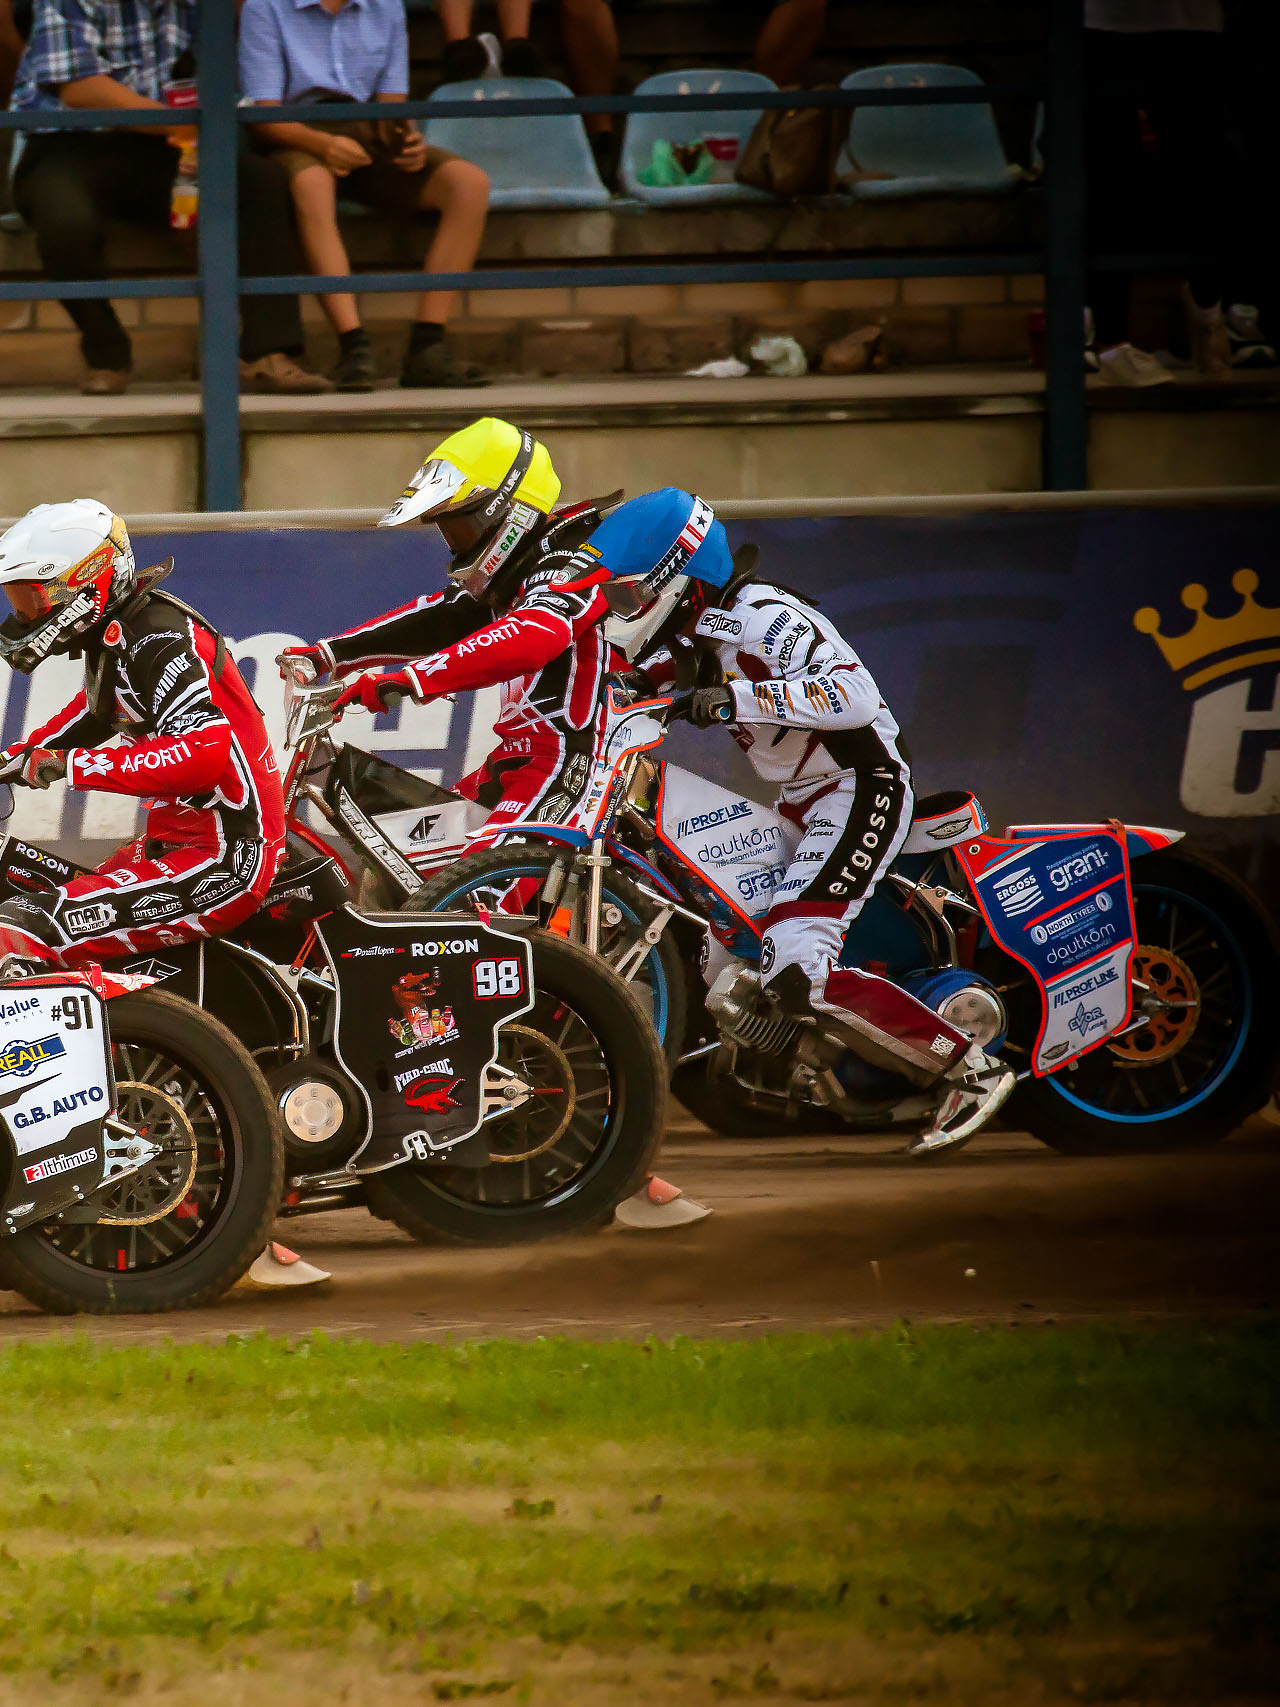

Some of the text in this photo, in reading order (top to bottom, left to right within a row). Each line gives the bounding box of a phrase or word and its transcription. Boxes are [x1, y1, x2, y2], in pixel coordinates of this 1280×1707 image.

[28, 593, 95, 657] MAD-CROC
[457, 622, 520, 657] AFORTI
[770, 683, 786, 719] ERGOSS
[817, 677, 843, 714] ERGOSS
[120, 740, 191, 773] AFORTI
[9, 865, 32, 878] moto
[15, 842, 70, 876] ROXON
[996, 875, 1037, 901] ERGOSS
[1048, 915, 1073, 934] NORTH
[1073, 904, 1096, 920] TYRES
[411, 939, 479, 957] ROXON
[475, 960, 520, 996] 98
[394, 1058, 454, 1093] MAD-CROC
[14, 1086, 104, 1129] G.B. AUTO
[23, 1148, 97, 1184] althimus
